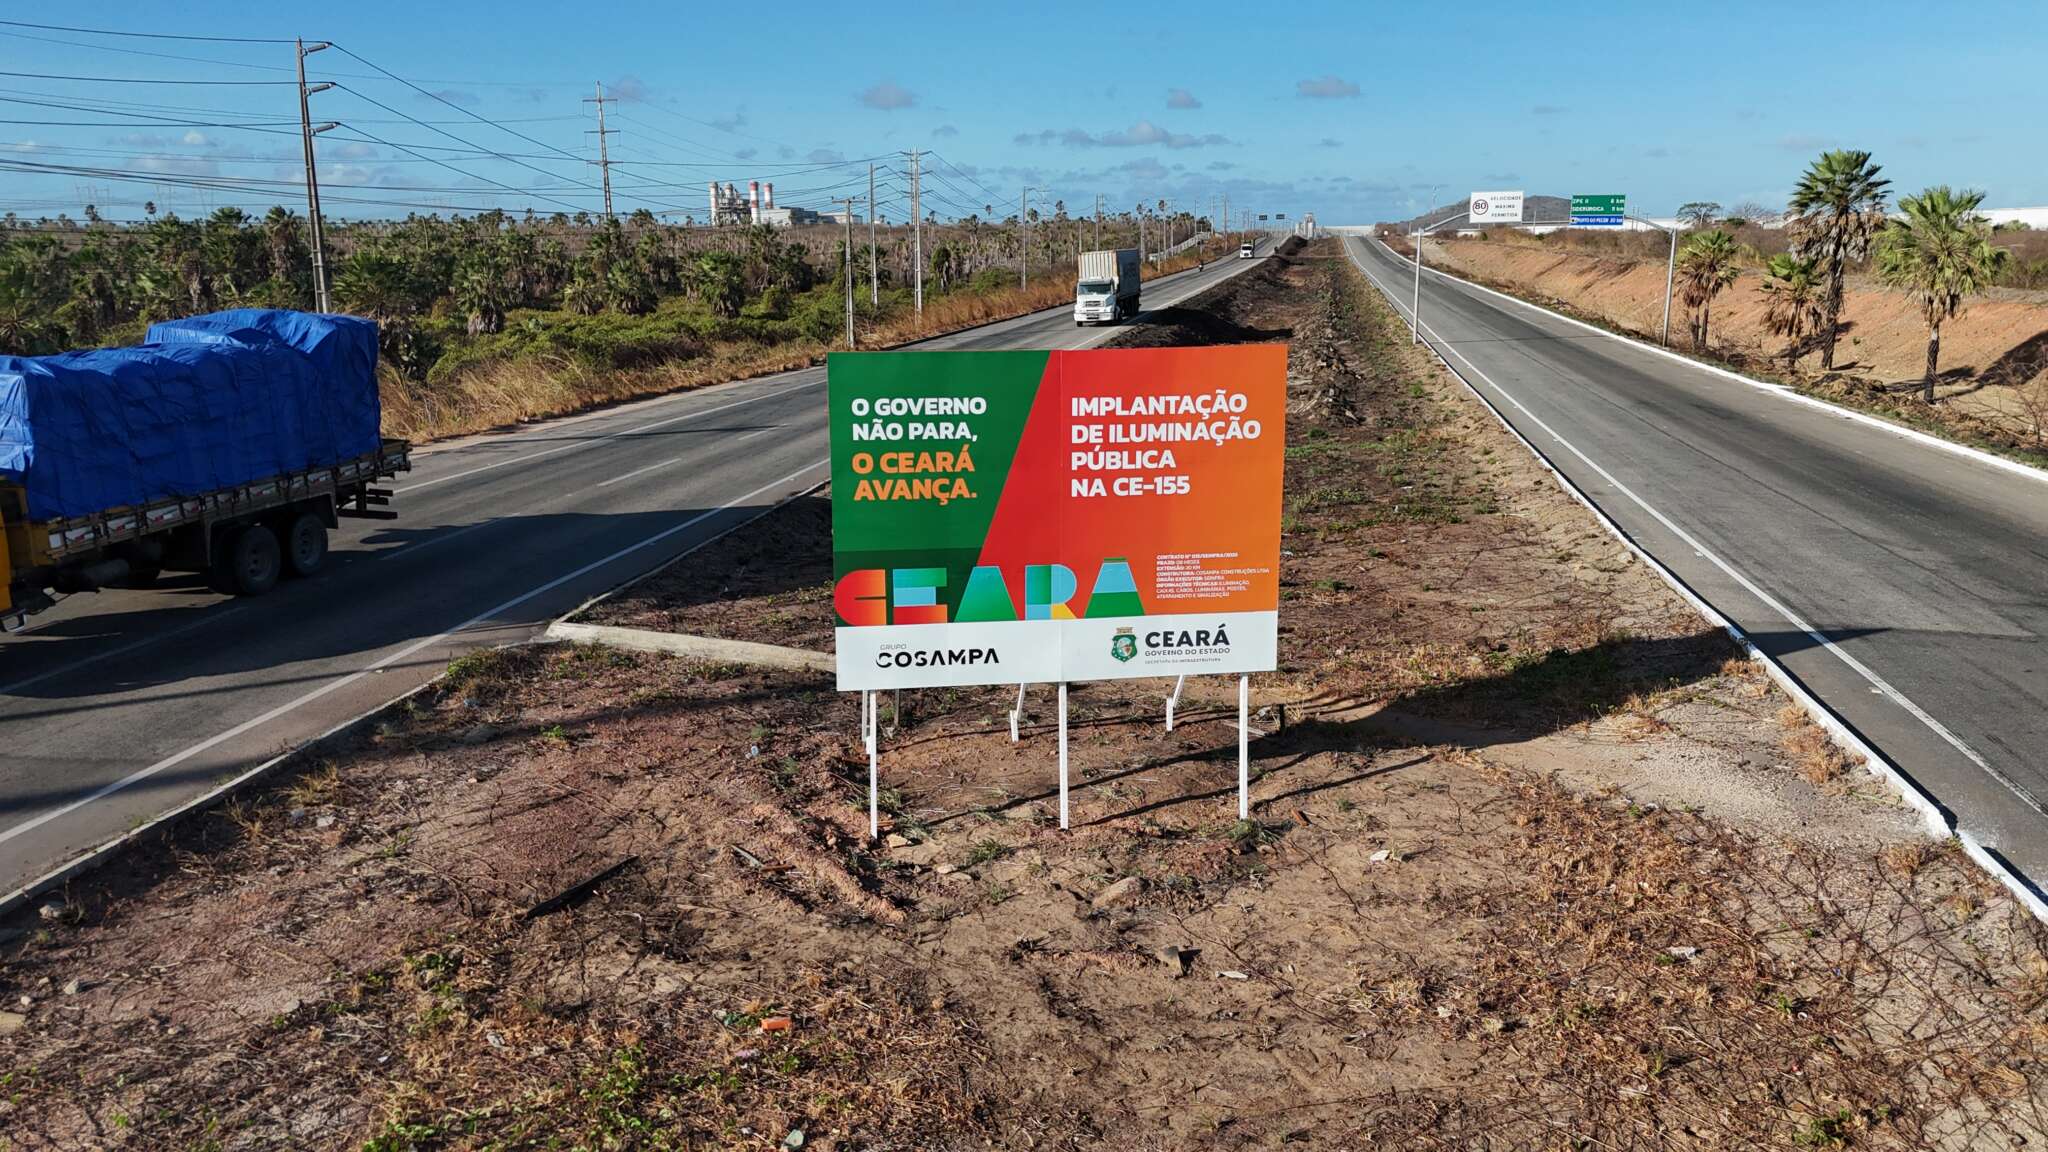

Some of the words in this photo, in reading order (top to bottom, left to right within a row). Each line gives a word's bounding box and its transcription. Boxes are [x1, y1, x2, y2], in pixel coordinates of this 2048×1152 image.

[852, 398, 869, 416] O
[874, 396, 986, 415] GOVERNO
[1071, 389, 1248, 420] IMPLANTAÇÃO
[853, 418, 903, 441] NÃO
[909, 421, 978, 442] PARA,
[1071, 424, 1103, 444] DE
[1109, 416, 1260, 446] ILUMINAÇÃO
[852, 453, 874, 474] O
[880, 445, 975, 473] CEARÁ
[1071, 445, 1176, 471] PÚBLICA
[854, 477, 977, 505] AVANÇA.
[1071, 478, 1106, 498] NA
[1113, 475, 1191, 496] CE-155
[1145, 623, 1230, 648] CEARÁ
[875, 648, 1000, 669] COSAMPA
